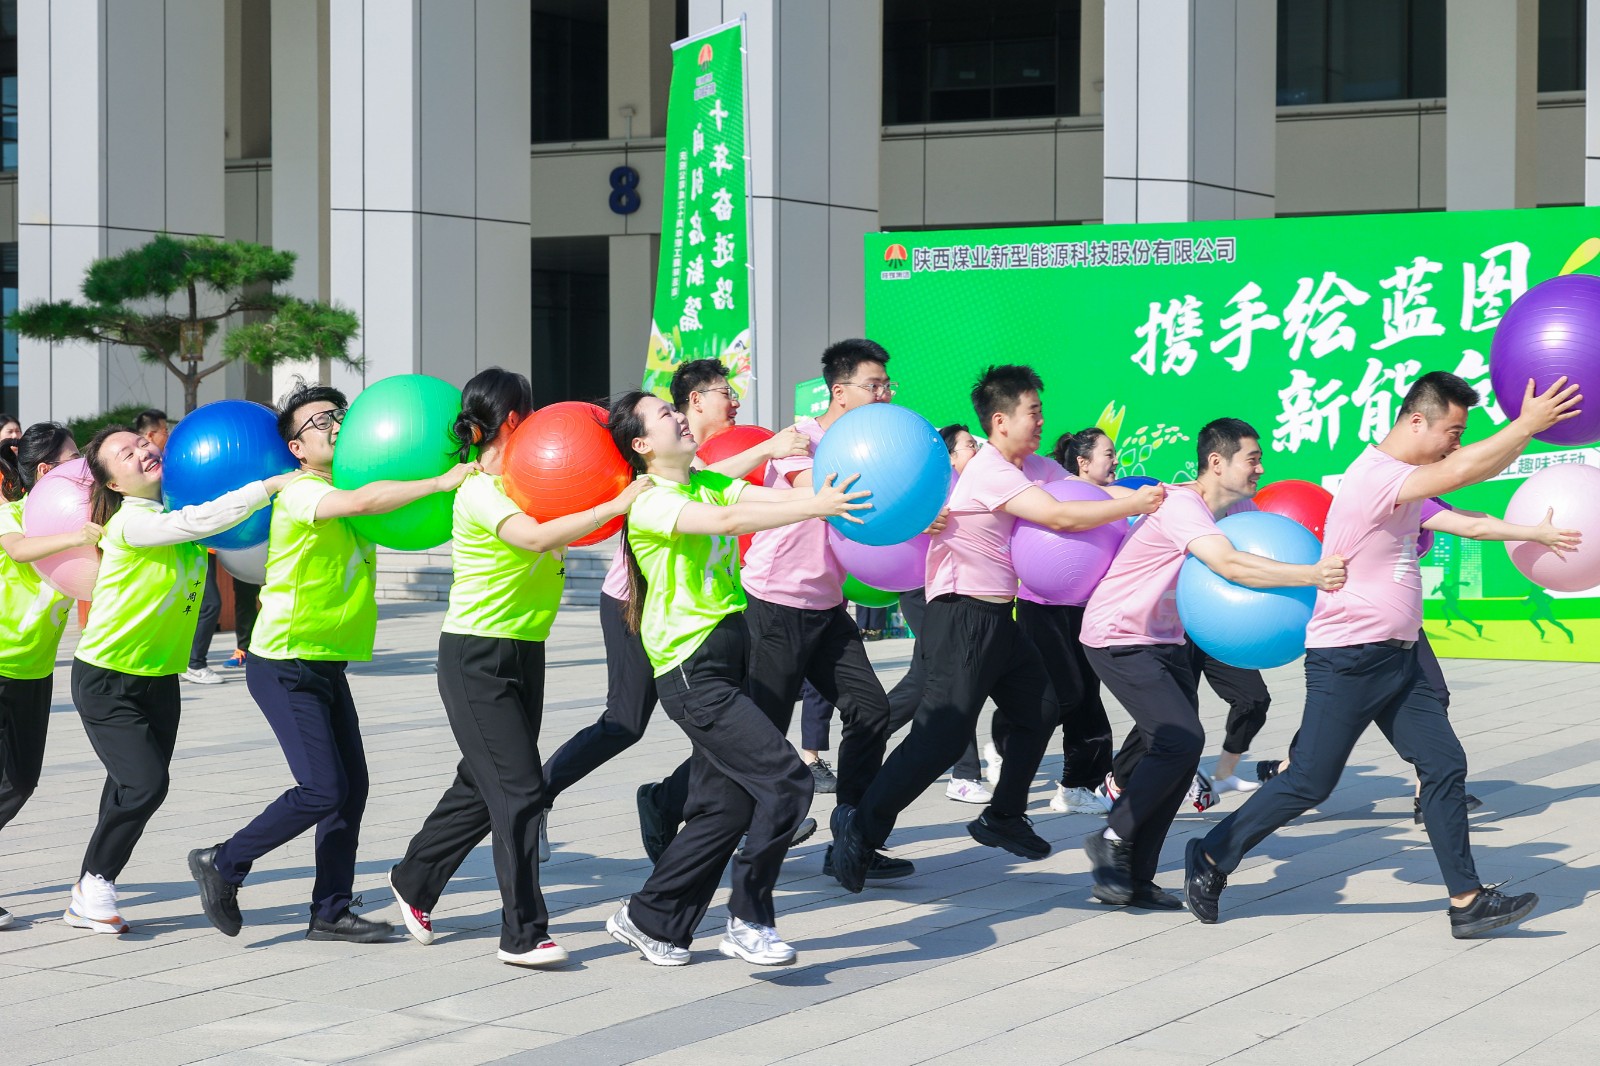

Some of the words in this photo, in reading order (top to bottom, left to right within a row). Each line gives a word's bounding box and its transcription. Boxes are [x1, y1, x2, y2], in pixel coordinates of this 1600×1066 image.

[609, 166, 641, 215] 8
[912, 237, 1237, 272] 陕西煤业新型能源科技股份有限公司
[1130, 241, 1532, 376] 携手绘蓝图
